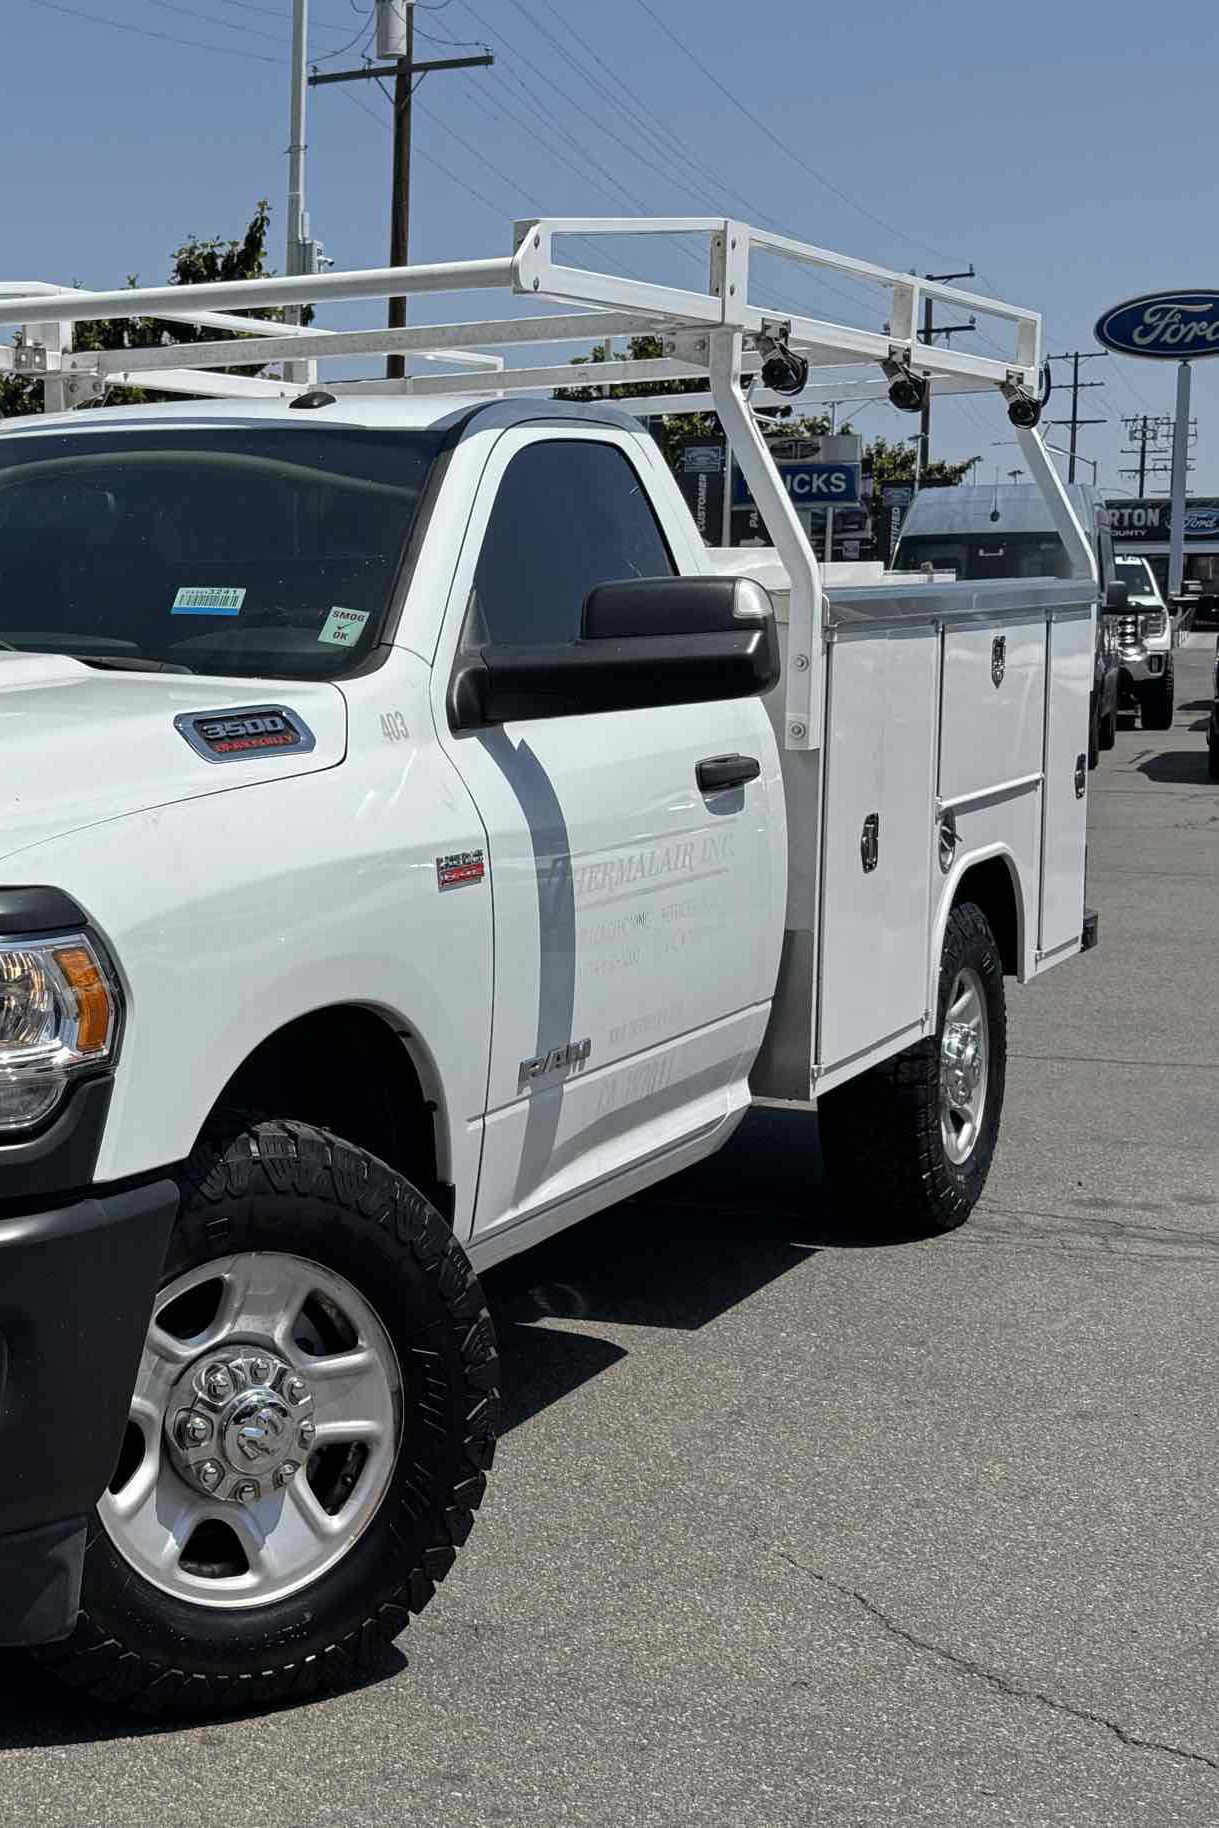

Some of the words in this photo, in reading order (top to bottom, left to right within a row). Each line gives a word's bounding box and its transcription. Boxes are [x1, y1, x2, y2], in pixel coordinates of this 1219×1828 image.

[1111, 529, 1148, 537] OUNTY
[333, 610, 365, 622] SMOG
[333, 631, 350, 641] OK
[203, 717, 284, 740] 3500
[380, 710, 410, 741] 403
